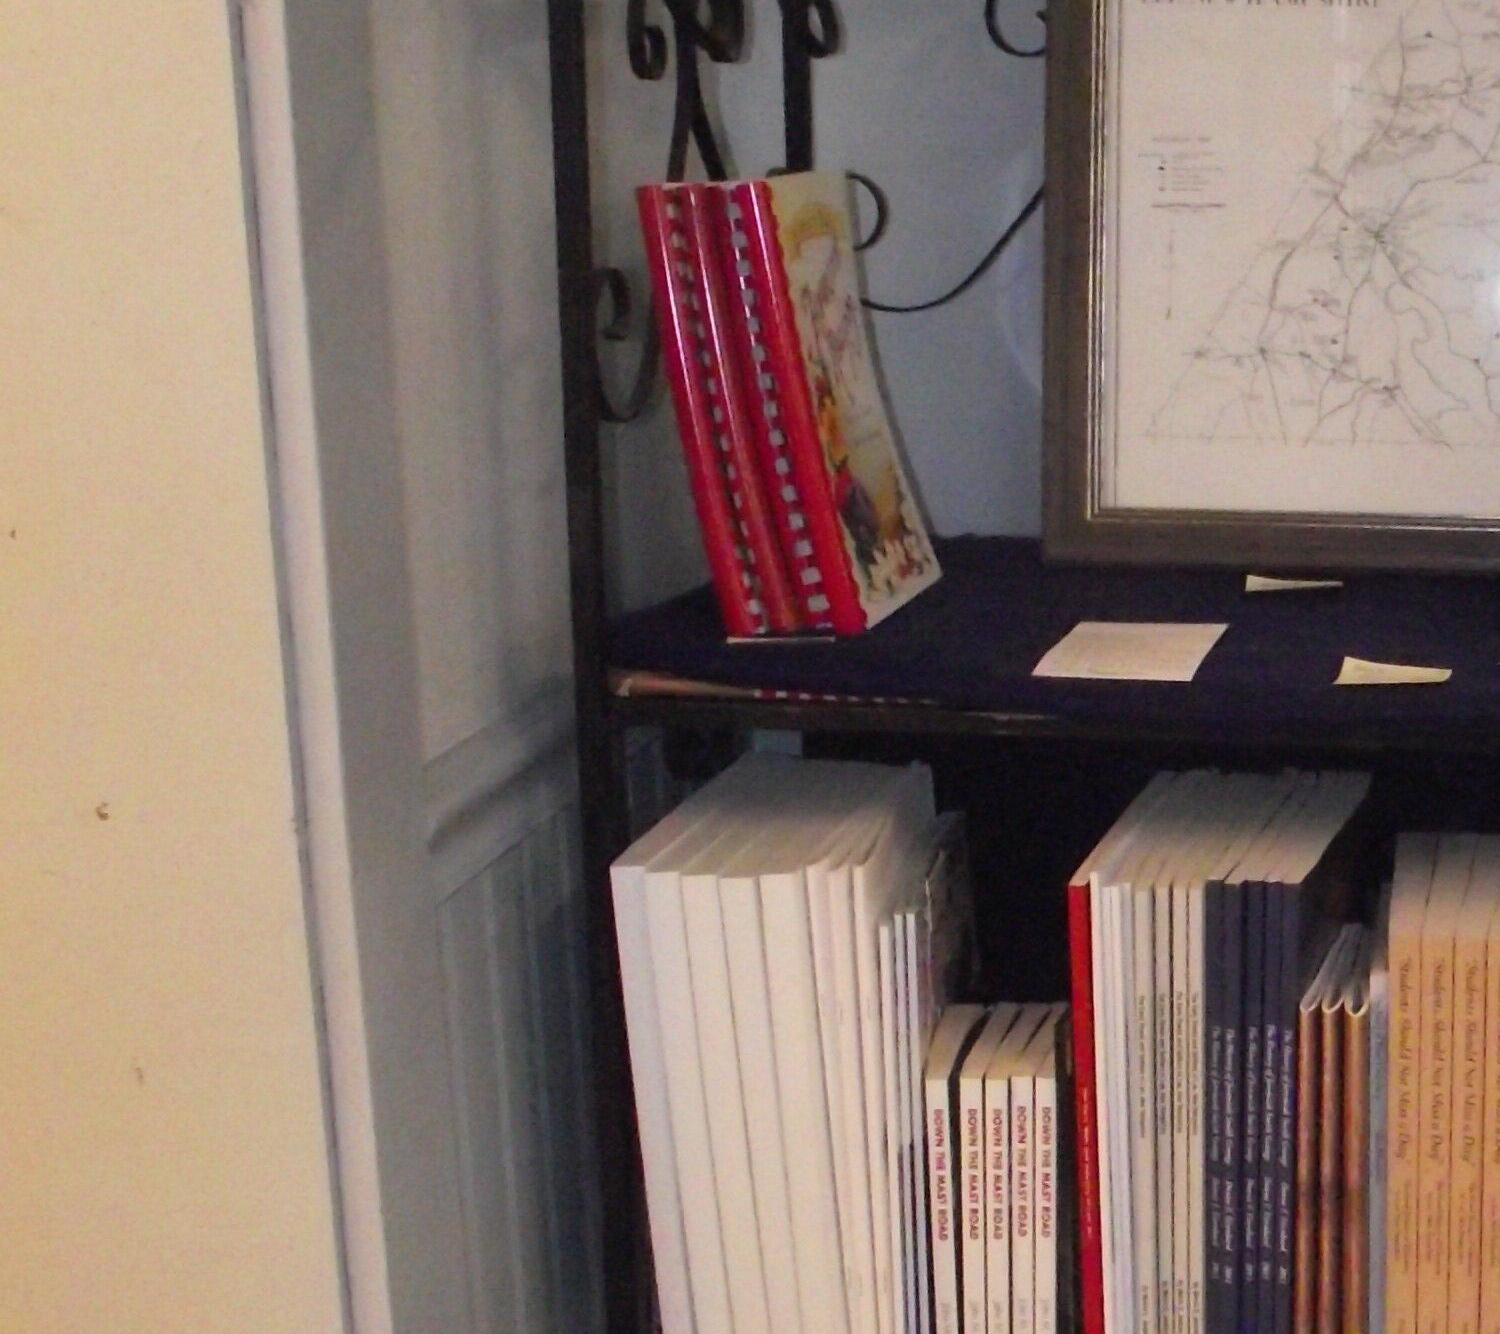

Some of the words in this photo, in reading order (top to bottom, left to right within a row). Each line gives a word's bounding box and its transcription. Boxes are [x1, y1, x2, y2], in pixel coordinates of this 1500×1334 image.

[1398, 1018, 1412, 1060] Should
[1431, 1019, 1444, 1061] Should
[1463, 1020, 1477, 1062] Should
[1398, 1066, 1410, 1085] Not
[1431, 1067, 1443, 1086] Not
[1463, 1068, 1475, 1088] Not
[1398, 1091, 1411, 1118] Miss
[1430, 1091, 1443, 1119] Miss
[1463, 1093, 1475, 1122] Miss
[933, 1108, 944, 1147] DOWN
[968, 1108, 978, 1147] DOWN
[993, 1108, 1002, 1146] DOWN
[1017, 1105, 1027, 1144] DOWN
[1041, 1106, 1051, 1145] DOWN
[935, 1151, 945, 1171] THE
[968, 1151, 978, 1169] THE
[993, 1151, 1002, 1169] THE
[1017, 1148, 1027, 1166] THE
[1042, 1149, 1051, 1168] THE
[936, 1174, 947, 1204] MAST
[969, 1174, 978, 1204] MAST
[993, 1174, 1002, 1204] MAST
[1017, 1171, 1027, 1201] MAST
[1041, 1172, 1051, 1202] MAST
[937, 1208, 948, 1241] ROAD
[969, 1208, 979, 1240] ROAD
[993, 1208, 1002, 1240] ROAD
[1018, 1204, 1027, 1237] ROAD
[1041, 1206, 1051, 1238] ROAD
